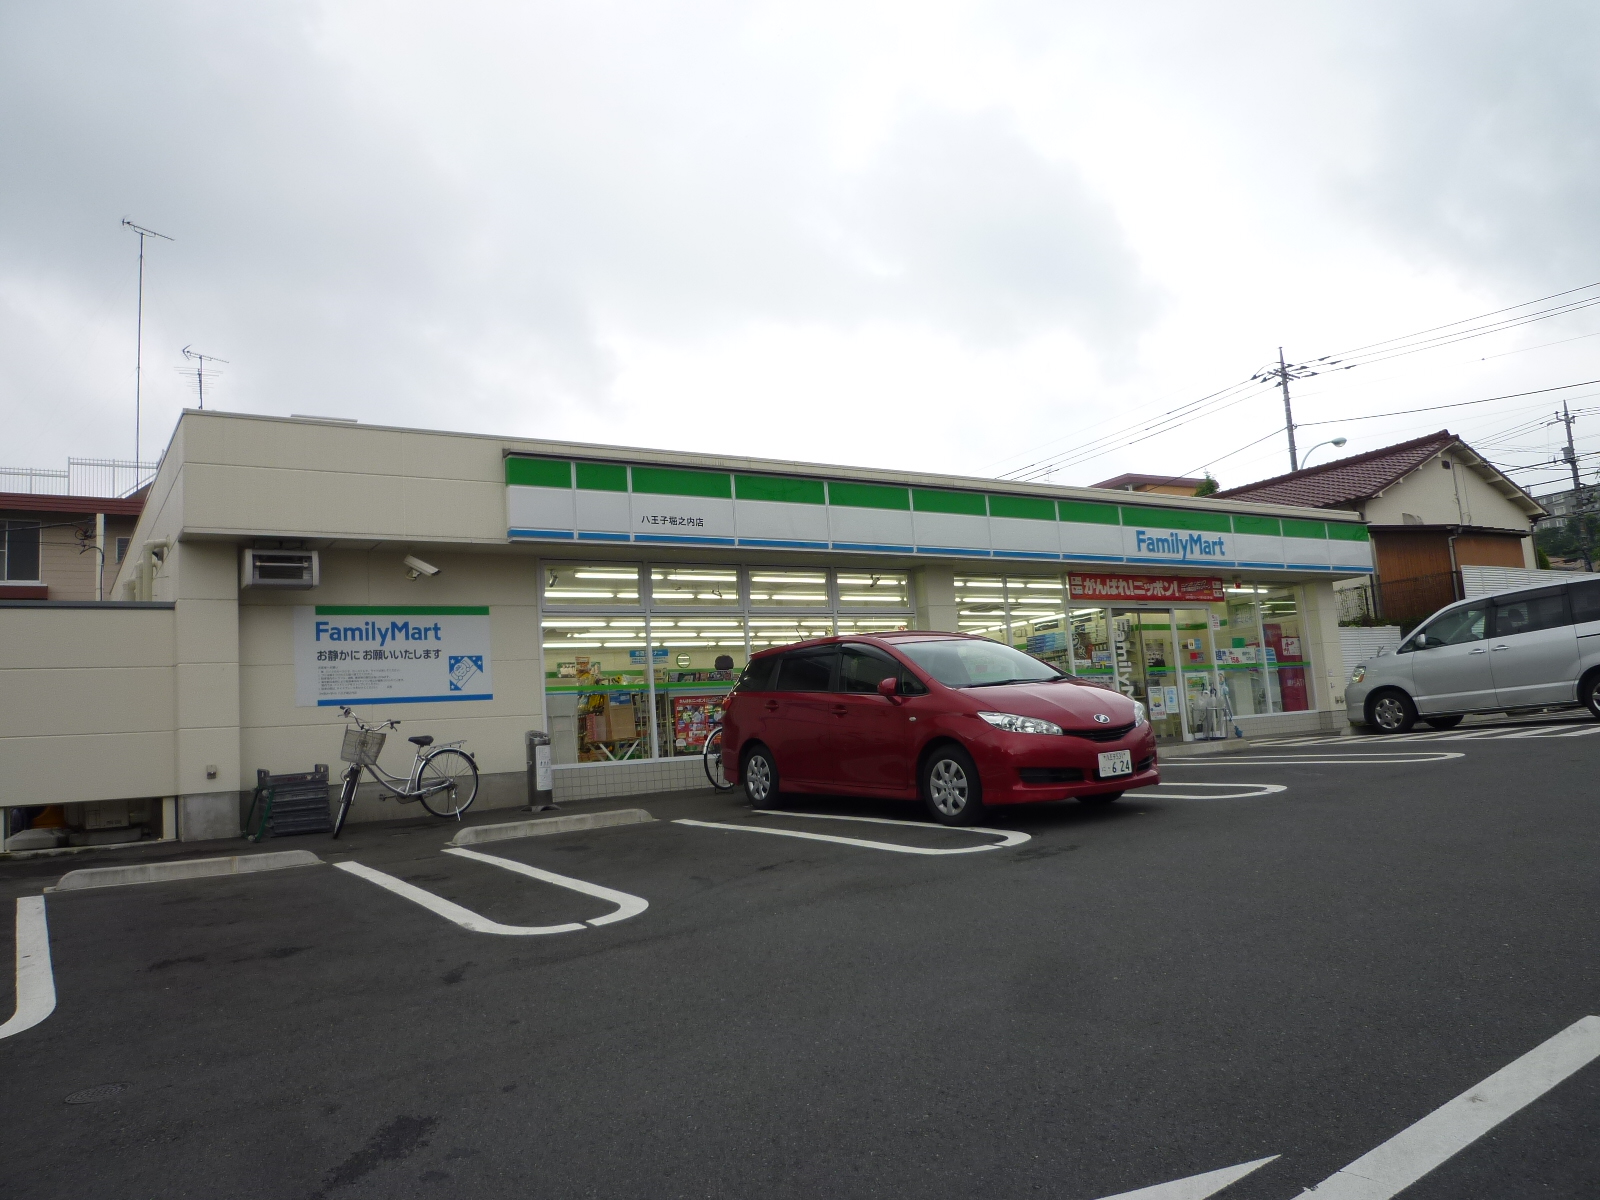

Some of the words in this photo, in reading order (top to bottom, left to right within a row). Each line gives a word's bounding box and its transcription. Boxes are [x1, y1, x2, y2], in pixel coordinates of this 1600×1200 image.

[641, 515, 704, 527] 八王子堀之内店
[1135, 530, 1225, 560] FamilyMart
[315, 621, 441, 647] FamilyMart
[316, 650, 360, 661] お静かに
[362, 649, 442, 660] お願いいたします
